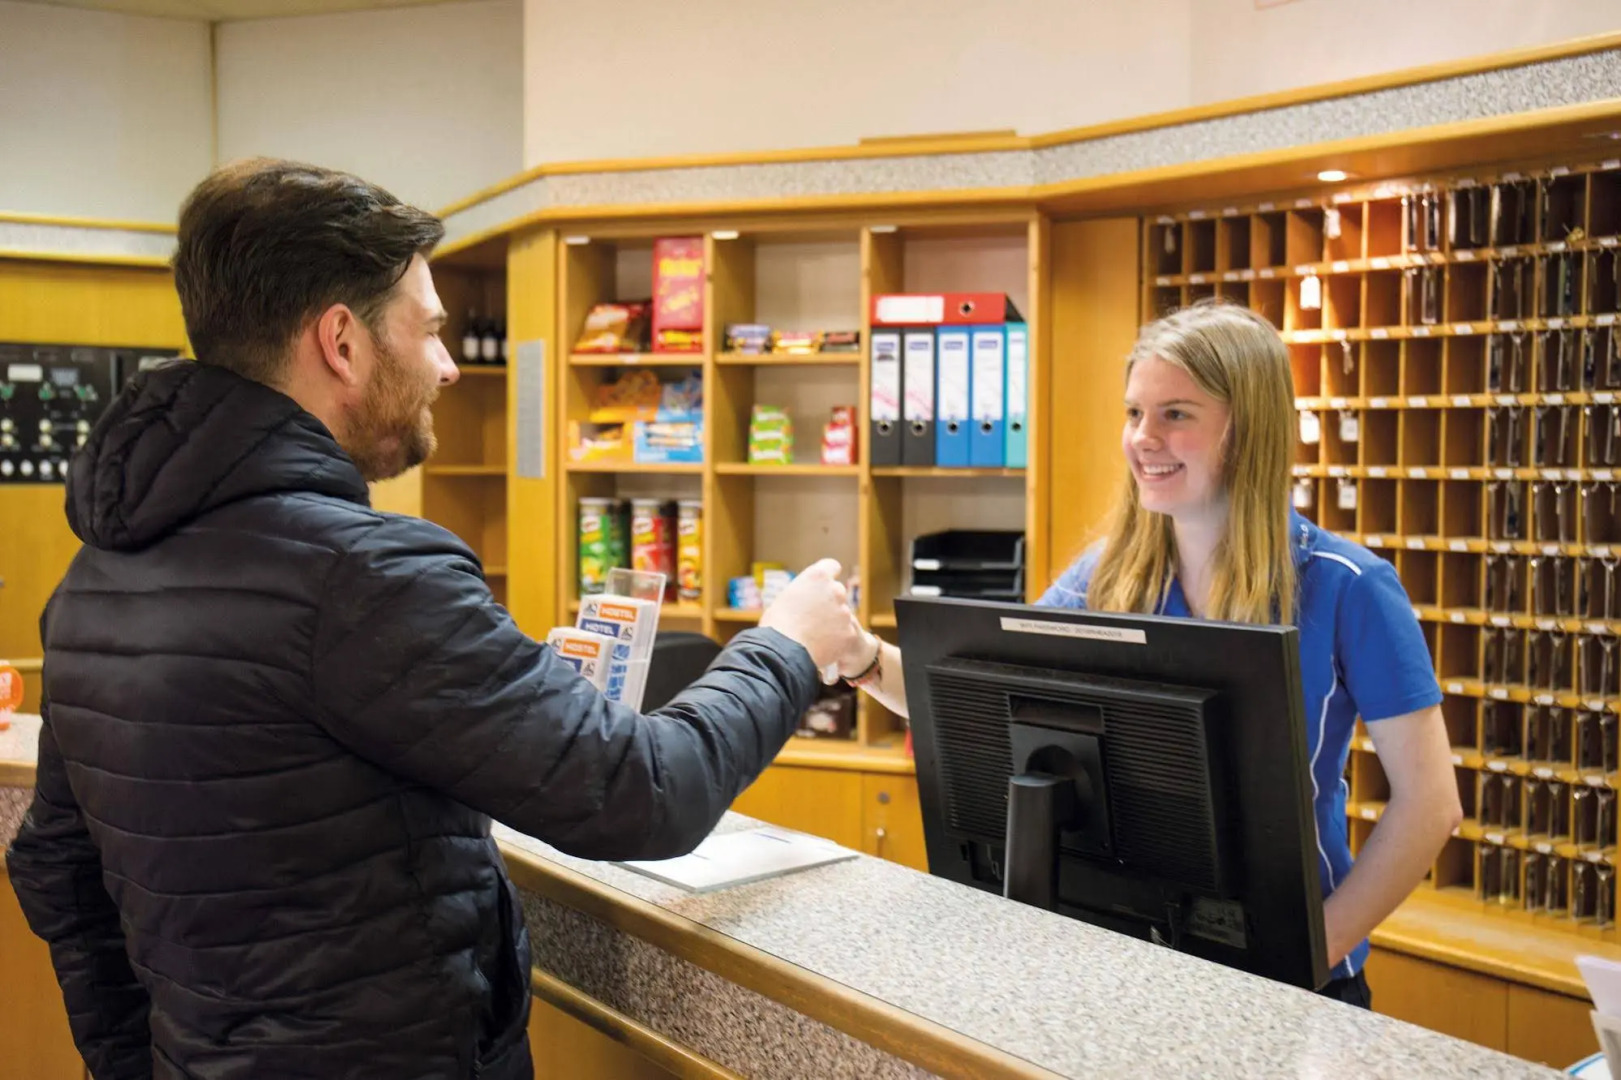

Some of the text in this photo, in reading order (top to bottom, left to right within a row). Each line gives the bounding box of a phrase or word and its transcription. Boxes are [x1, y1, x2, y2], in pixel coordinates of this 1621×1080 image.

[601, 607, 633, 620] HOSTEL
[585, 622, 614, 635] HOTEL
[565, 642, 597, 655] HOSTEL
